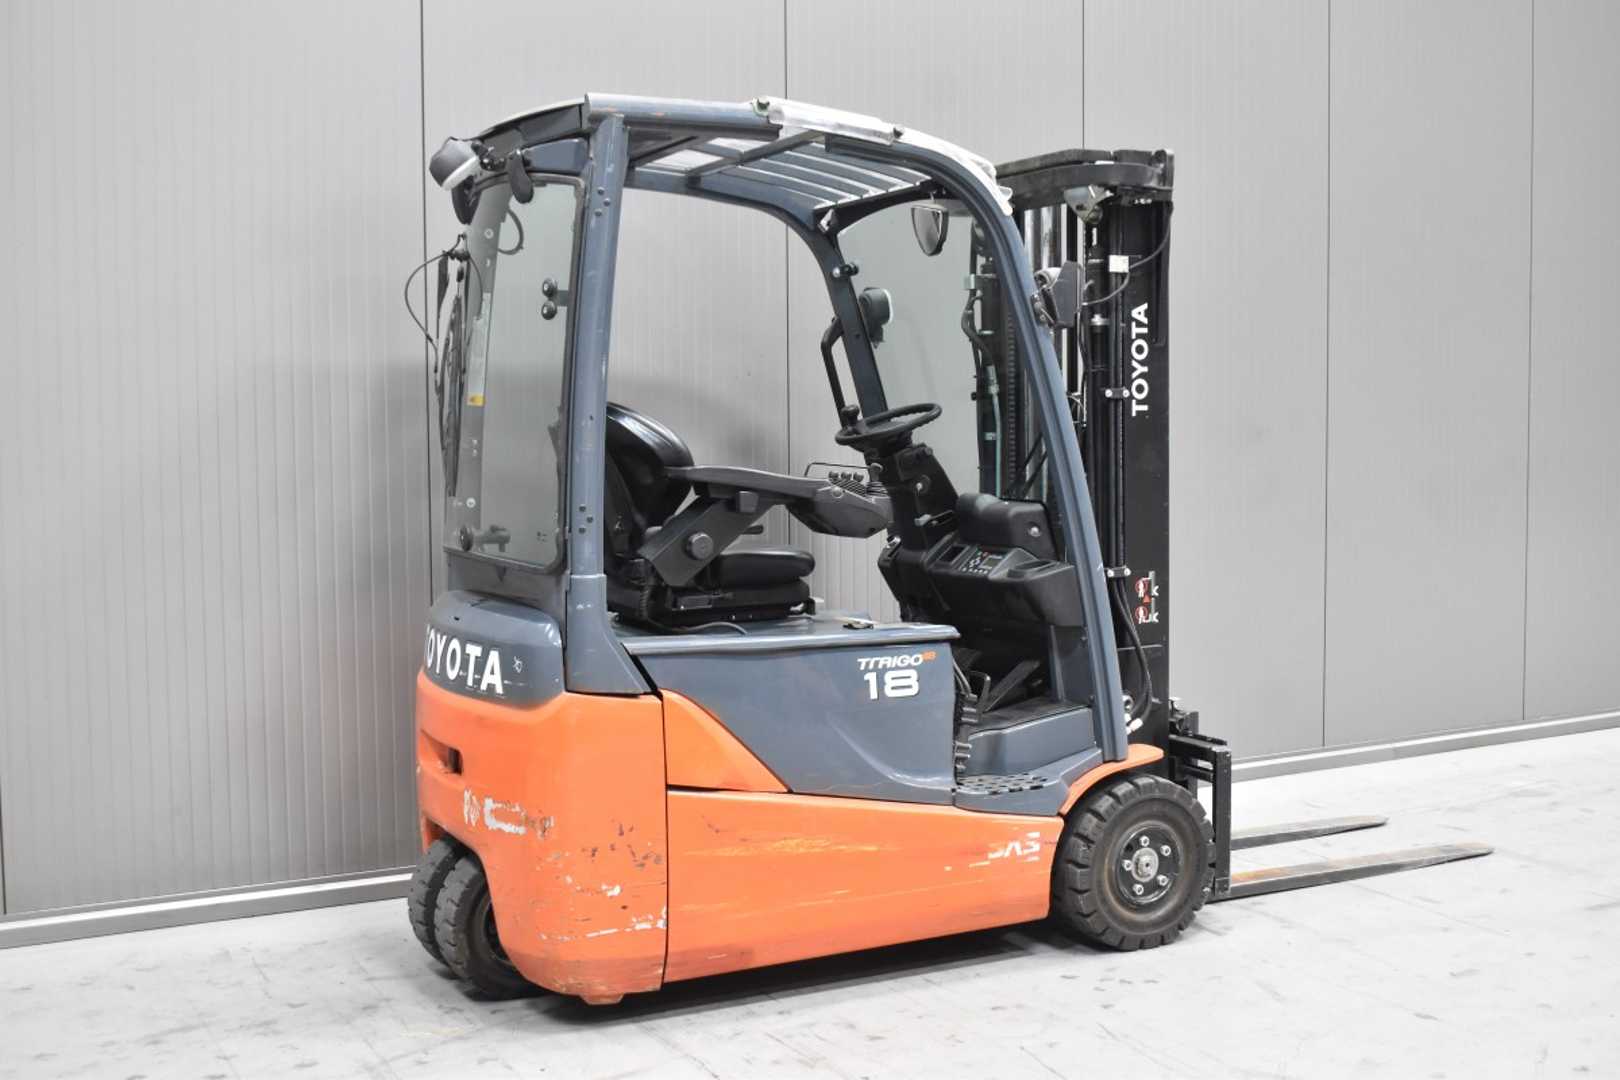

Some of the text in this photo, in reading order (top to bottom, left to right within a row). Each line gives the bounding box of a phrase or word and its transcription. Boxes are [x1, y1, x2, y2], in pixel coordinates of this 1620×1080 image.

[1131, 302, 1149, 417] TOYOTA
[425, 624, 504, 694] OYOTA
[863, 669, 919, 700] 18
